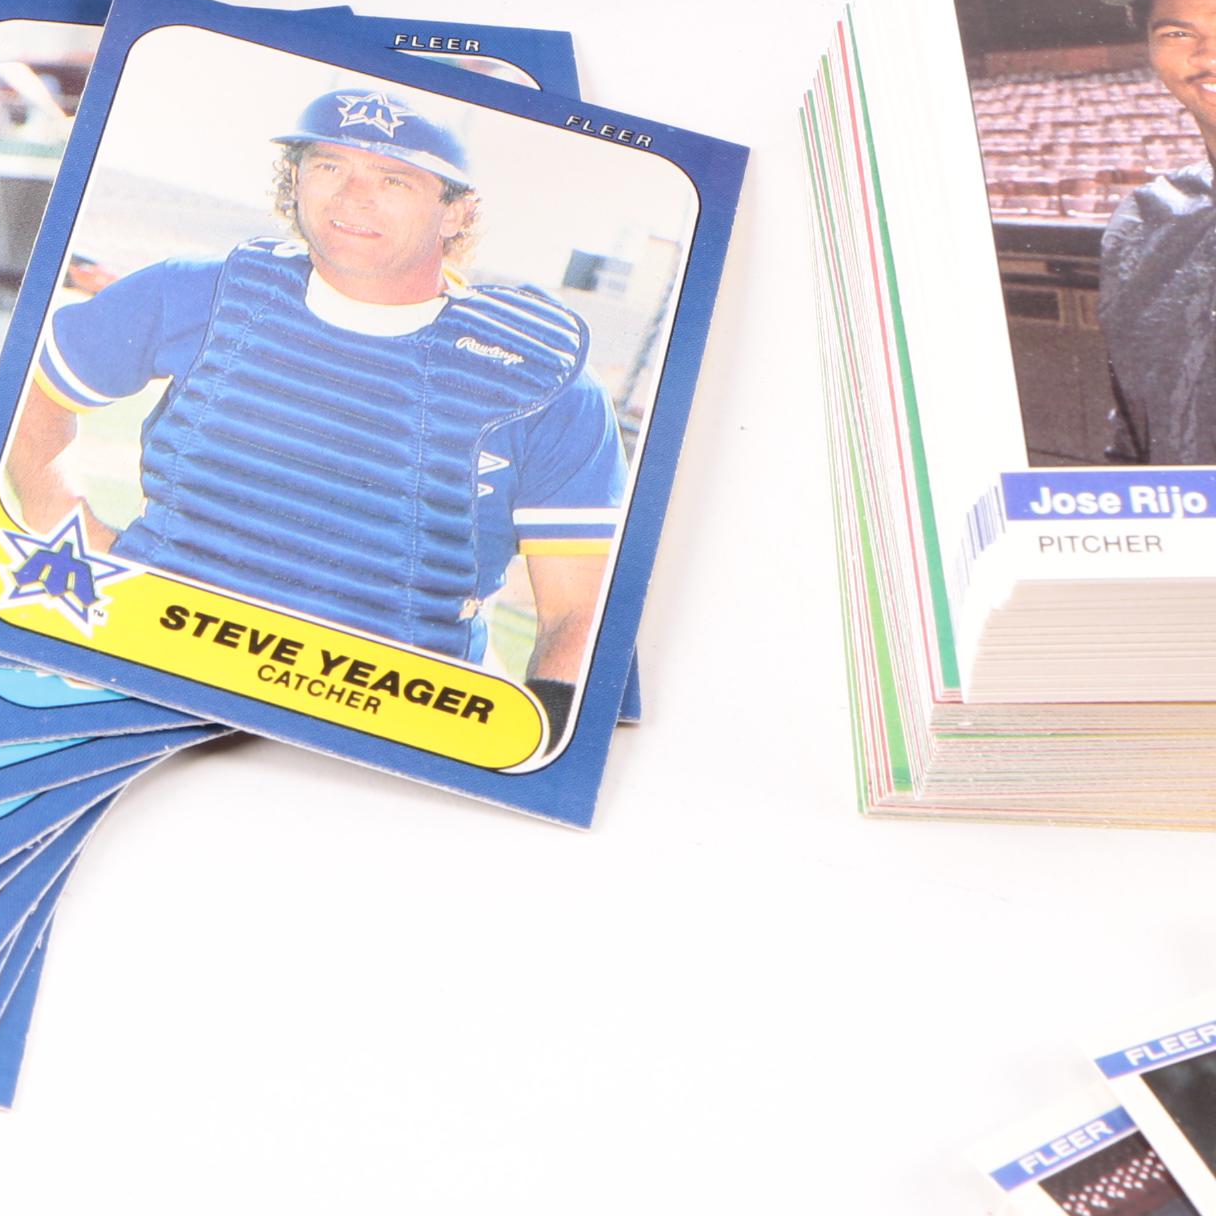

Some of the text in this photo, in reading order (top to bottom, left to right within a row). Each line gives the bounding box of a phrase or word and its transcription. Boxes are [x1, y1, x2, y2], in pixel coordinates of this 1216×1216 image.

[394, 34, 481, 53] FLEER
[565, 115, 653, 148] FLEER
[1030, 486, 1208, 519] Jose Rijo
[1039, 535, 1163, 553] PITCHER
[159, 605, 495, 725] STEVE YEAGER
[257, 664, 382, 716] CATCHER
[1123, 1024, 1216, 1066] FLEER
[1018, 1119, 1114, 1175] FLEER
